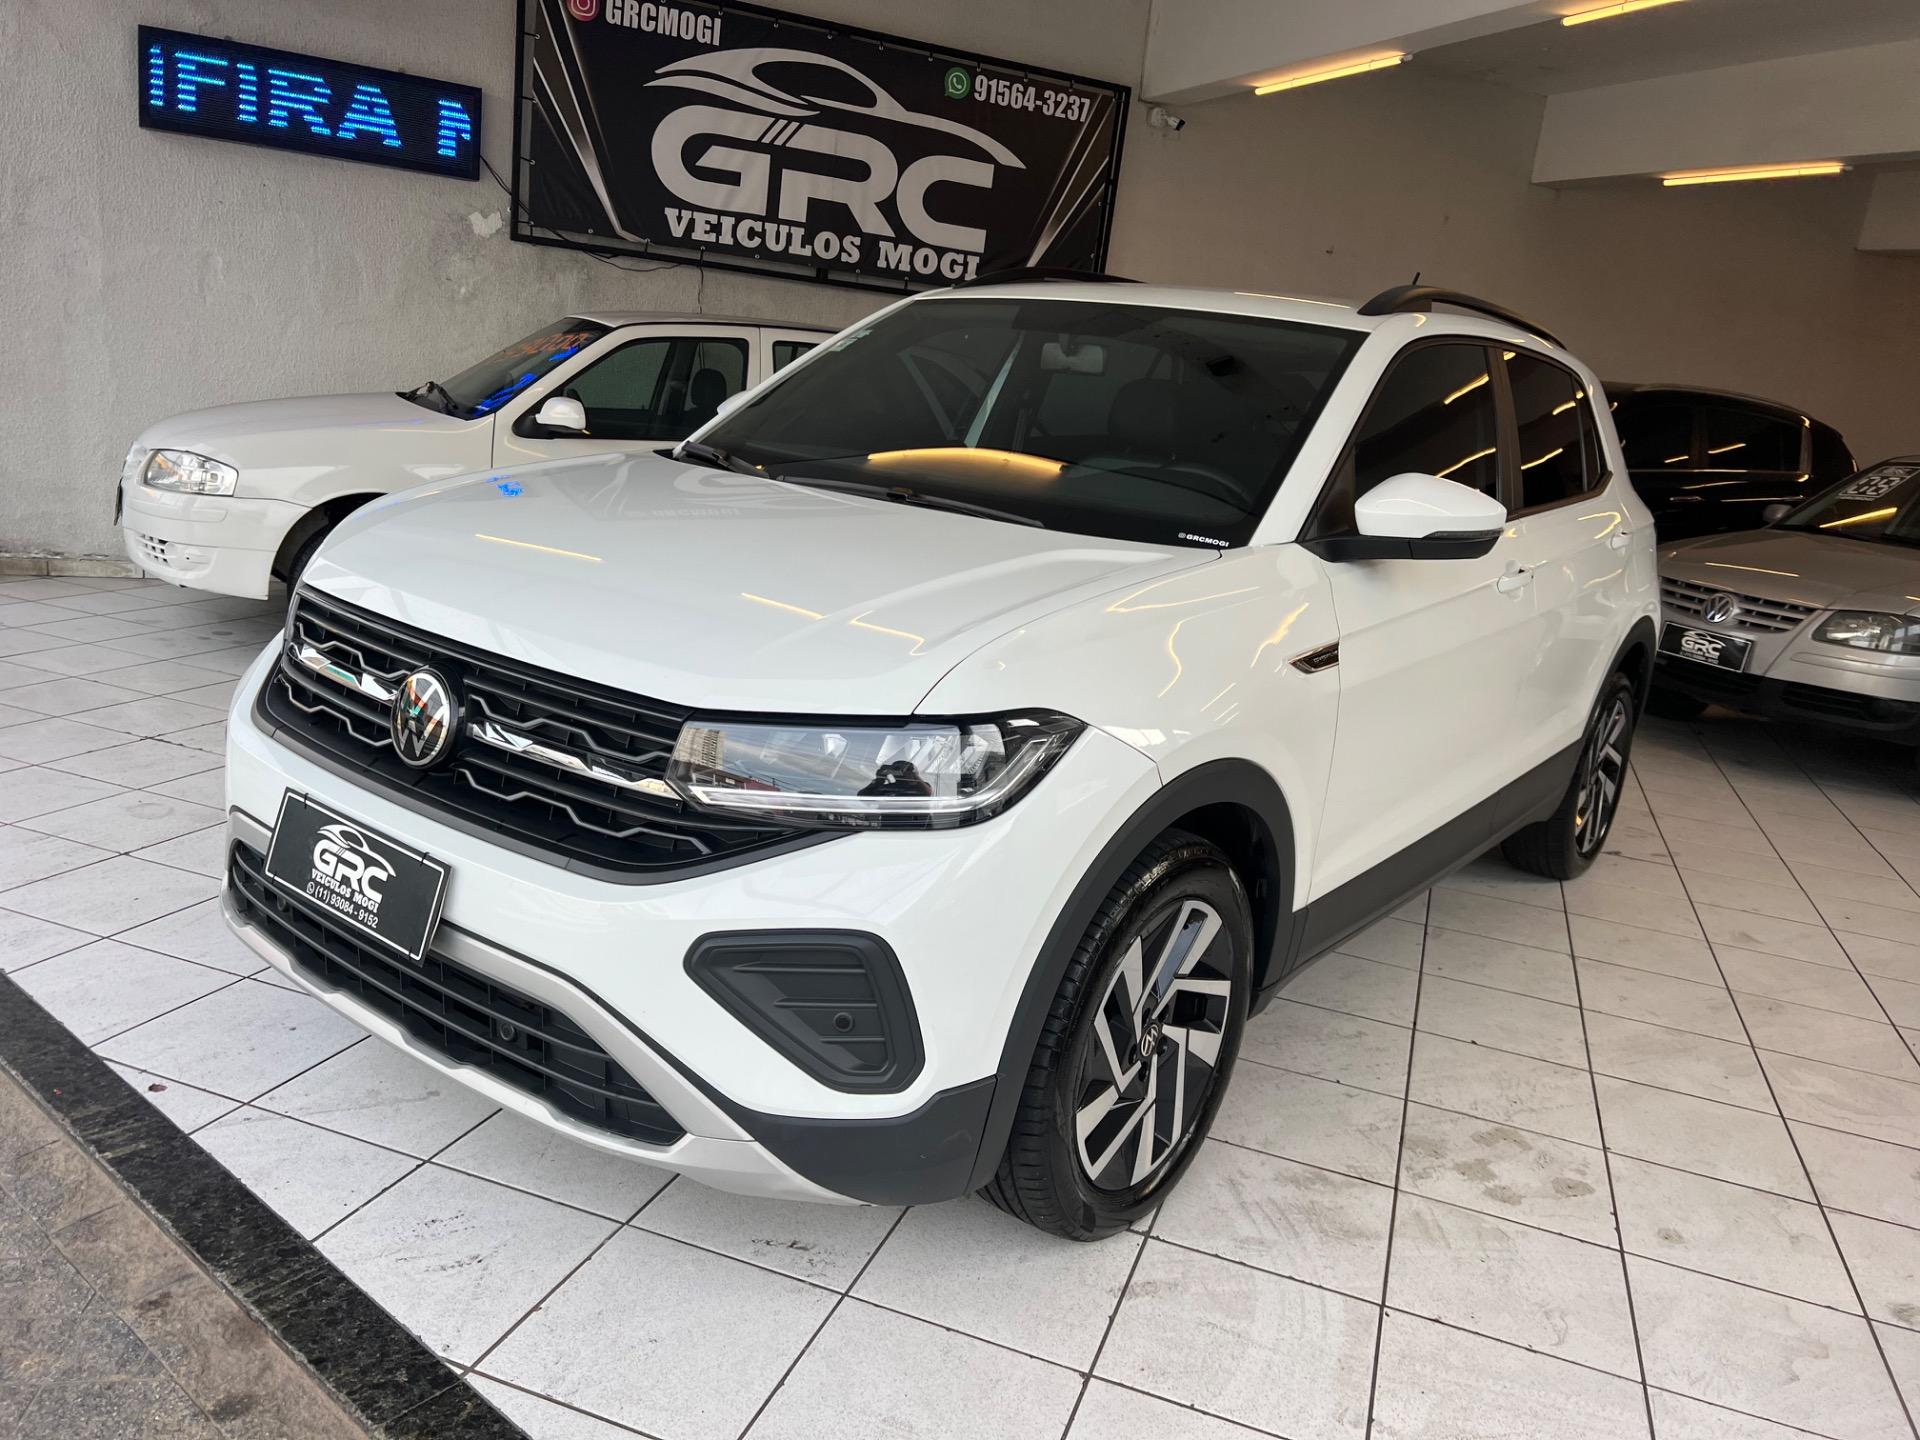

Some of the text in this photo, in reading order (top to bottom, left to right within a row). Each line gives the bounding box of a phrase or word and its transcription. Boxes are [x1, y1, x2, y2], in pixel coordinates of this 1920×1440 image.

[605, 0, 722, 46] GRCMOGI
[974, 74, 1091, 122] 91564-3237
[651, 104, 995, 254] GRC
[664, 207, 980, 281] VEICULOS MOGI
[1186, 533, 1230, 547] GRCMOGI
[1681, 636, 1722, 656] GRC
[311, 867, 379, 913] VEICULOS MOGI
[313, 838, 389, 904] GRC
[314, 885, 331, 904] (11)
